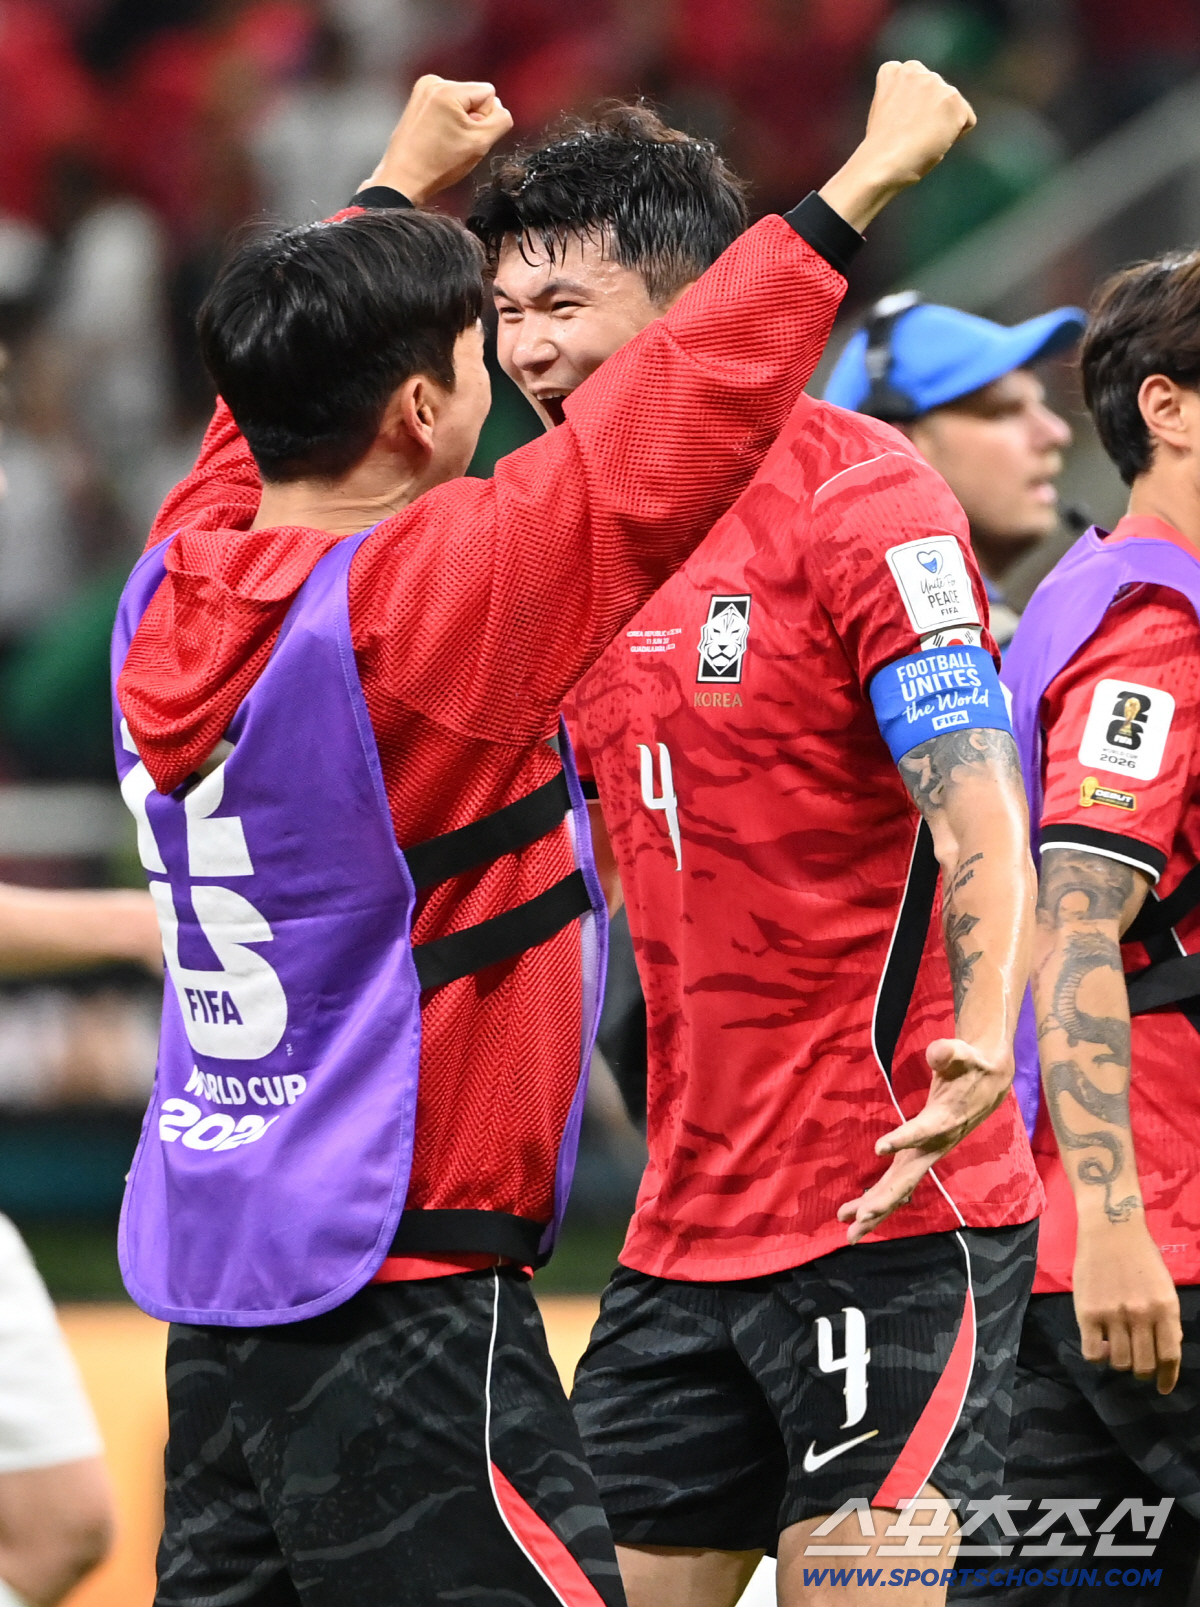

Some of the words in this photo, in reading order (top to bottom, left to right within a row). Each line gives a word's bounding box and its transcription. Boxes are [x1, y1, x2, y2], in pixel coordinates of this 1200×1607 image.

[928, 590, 960, 608] PEACE
[941, 607, 959, 616] FIFA
[896, 652, 976, 682] FOOTBALL
[694, 692, 743, 708] KOREA
[901, 668, 982, 702] UNITES
[902, 701, 935, 724] the
[936, 687, 989, 712] World
[936, 713, 967, 727] FIFA
[1100, 754, 1136, 769] 2026
[636, 742, 682, 872] 4
[1095, 789, 1133, 803] DEBUT
[184, 987, 244, 1025] FIFA
[248, 1073, 307, 1106] CUP
[815, 1306, 871, 1430] 4
